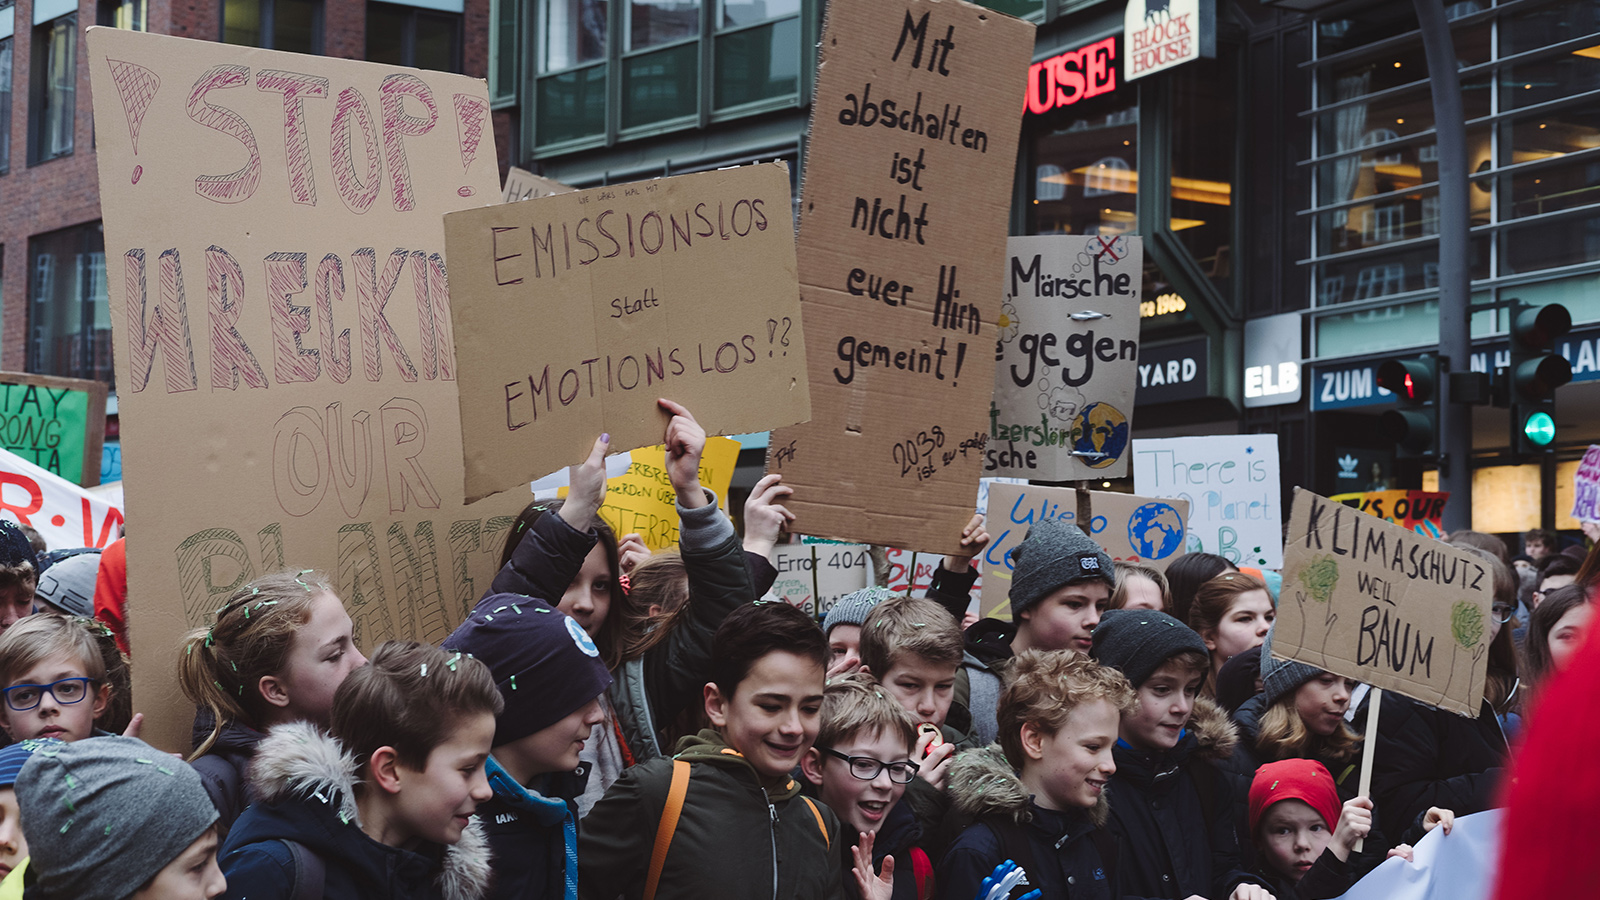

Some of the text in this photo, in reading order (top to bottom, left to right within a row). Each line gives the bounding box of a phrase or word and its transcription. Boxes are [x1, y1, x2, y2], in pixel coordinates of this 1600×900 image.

[892, 9, 954, 76] Mit
[1132, 13, 1192, 51] BLOCK
[1131, 36, 1192, 74] HOUSE
[1022, 36, 1116, 115] USE
[838, 83, 988, 153] abschalten
[889, 148, 926, 191] ist
[851, 195, 929, 245] nicht
[491, 199, 769, 286] EMISSIONSLOS
[847, 265, 982, 335] euer Hirn
[833, 336, 967, 388] gemeint!
[1010, 330, 1137, 388] gegen
[1244, 361, 1299, 399] ELB
[1320, 368, 1372, 402] ZUM
[272, 397, 442, 518] OUR
[893, 426, 945, 477] 2038
[917, 455, 937, 481] ist
[985, 440, 1037, 470] sche
[1137, 448, 1267, 487] There is
[1201, 490, 1272, 522] Planet
[1394, 498, 1446, 520] OUR
[777, 551, 867, 573] Error 404
[1218, 526, 1242, 565] B
[1306, 495, 1486, 592] KLIMASCHUTZ
[772, 580, 801, 597] green
[786, 582, 811, 596] earth
[1357, 570, 1396, 607] WEIL
[1356, 604, 1434, 679] BAUM
